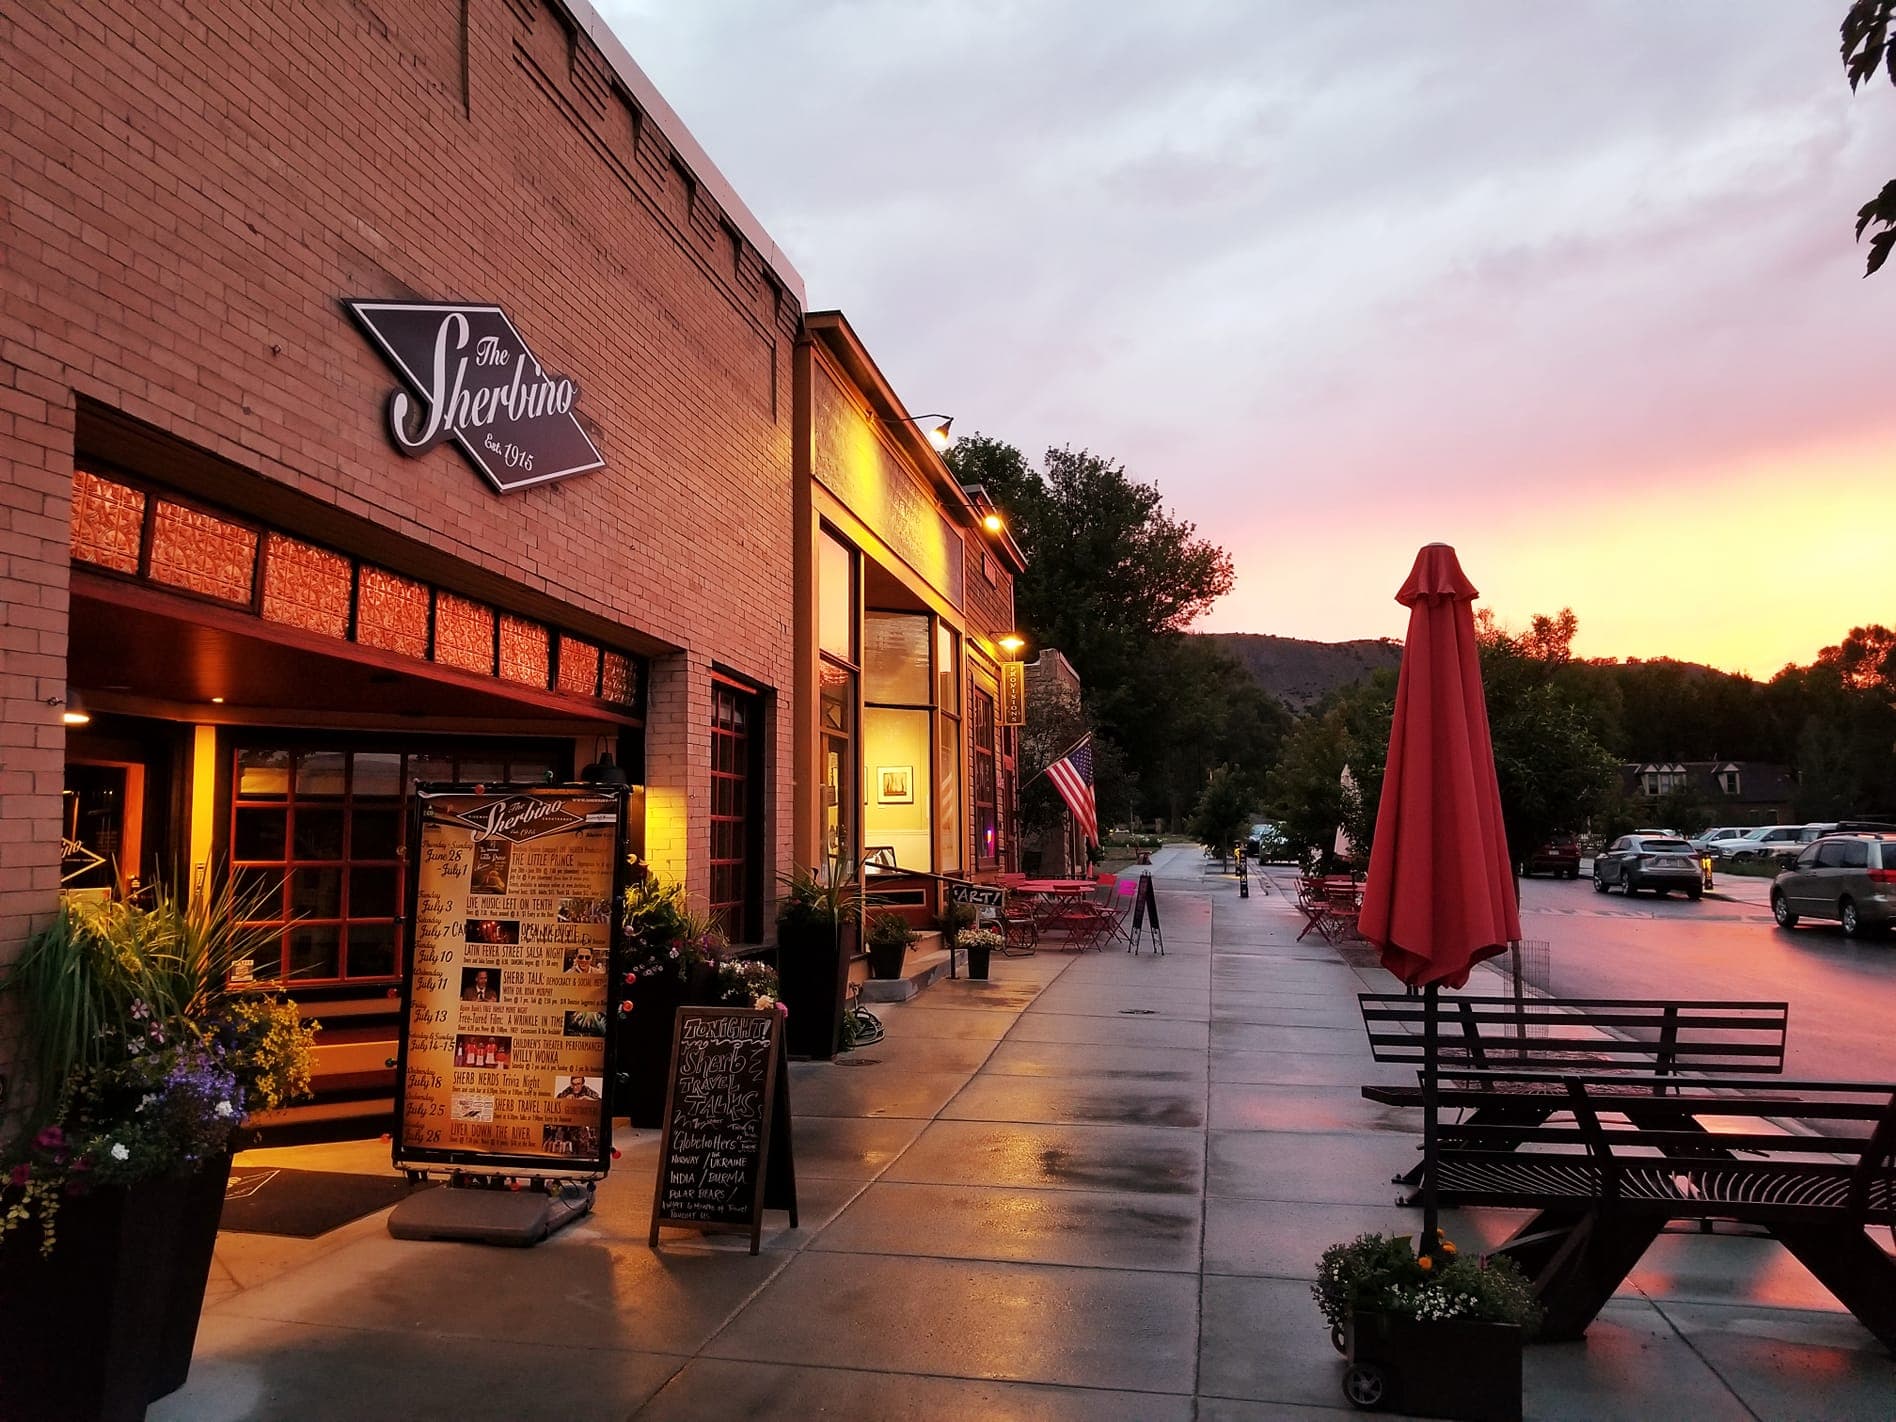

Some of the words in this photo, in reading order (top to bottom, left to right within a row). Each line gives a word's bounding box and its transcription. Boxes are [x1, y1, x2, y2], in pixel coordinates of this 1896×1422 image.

[475, 336, 510, 367] The
[393, 313, 578, 447] Sherbino
[484, 433, 502, 455] Est.
[505, 443, 534, 471] 1915
[508, 801, 525, 813] The
[471, 800, 564, 843] Sherbino
[426, 849, 447, 863] June
[448, 850, 462, 861] 28
[512, 853, 524, 866] THE
[528, 853, 547, 866] LITTLE
[551, 854, 574, 867] PRINCE
[463, 864, 468, 875] 1
[422, 900, 443, 914] July
[446, 900, 453, 912] 3
[467, 896, 478, 909] LIVE
[502, 898, 516, 910] LEFT
[520, 899, 529, 910] ON
[533, 899, 553, 911] TENTH
[420, 925, 441, 939] July
[443, 926, 450, 937] 7
[418, 950, 438, 965] July
[441, 951, 453, 963] 10
[465, 944, 480, 956] LATIN
[483, 945, 499, 957] FEVER
[502, 945, 523, 958] STREET
[527, 947, 543, 959] SALSA
[546, 947, 563, 960] NIGHT
[417, 977, 436, 991] July
[438, 978, 448, 989] 11
[504, 971, 524, 984] SHERB
[547, 977, 571, 986] DEMOCRACY
[503, 987, 513, 995] WITH
[414, 1009, 433, 1024] July
[435, 1010, 448, 1022] 13
[508, 1015, 512, 1025] A
[514, 1015, 538, 1027] WRINKLE
[542, 1016, 548, 1026] IN
[551, 1016, 563, 1028] TIME
[684, 1017, 771, 1039] TONIGHT!
[410, 1039, 428, 1053] July
[513, 1039, 541, 1049] CHILDREN'S
[544, 1040, 562, 1050] THEATER
[512, 1049, 532, 1062] WILLY
[536, 1050, 559, 1063] WONKA
[408, 1075, 429, 1089] July
[453, 1072, 475, 1085] SHERB
[478, 1073, 499, 1086] NERDS
[503, 1074, 519, 1087] Trivia
[523, 1074, 540, 1090] Night
[680, 1074, 740, 1096] TRAVEL
[407, 1103, 426, 1117] July
[430, 1104, 445, 1116] 25
[494, 1098, 514, 1111] SHERB
[518, 1100, 540, 1113] TRAVEL
[544, 1100, 561, 1114] TALKS
[684, 1090, 759, 1119] TALKS
[427, 1130, 441, 1142] 28
[451, 1122, 467, 1136] LIVER
[471, 1124, 491, 1137] DOWN
[496, 1125, 508, 1138] THE
[512, 1126, 531, 1139] RIVER
[710, 1157, 748, 1169] UKRAINE
[670, 1170, 695, 1185] INDIA
[709, 1170, 745, 1186] BURMA
[669, 1188, 695, 1200] POLAR
[699, 1188, 725, 1201] BEARS
